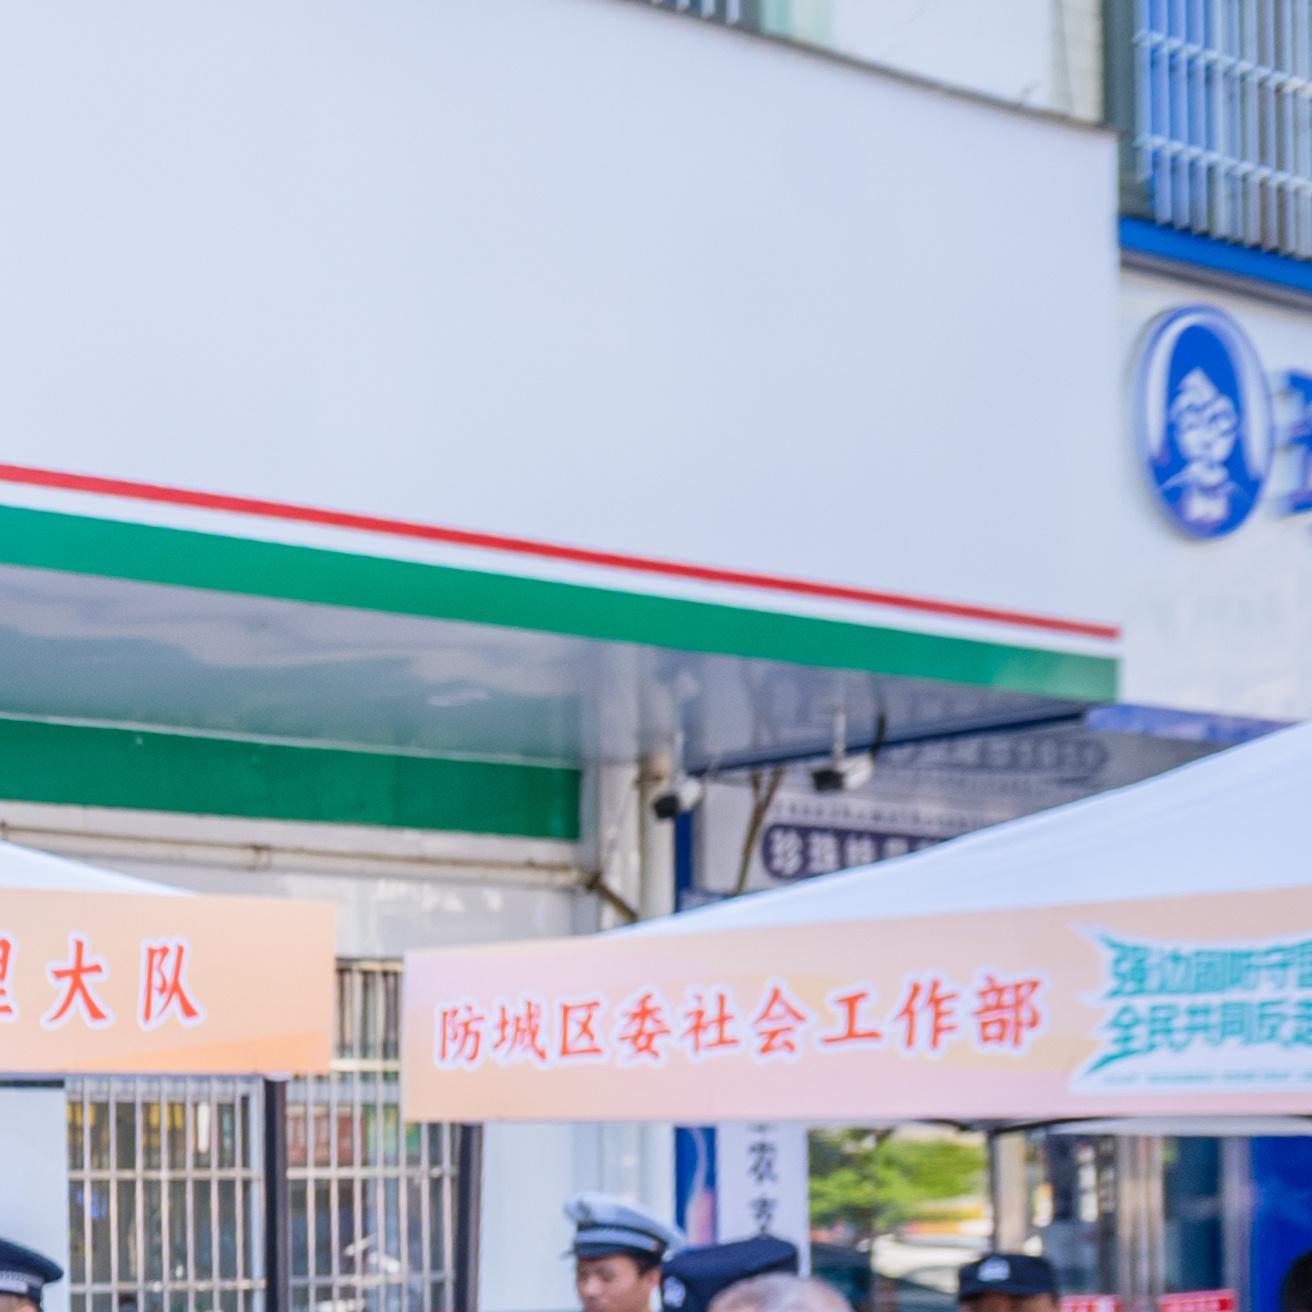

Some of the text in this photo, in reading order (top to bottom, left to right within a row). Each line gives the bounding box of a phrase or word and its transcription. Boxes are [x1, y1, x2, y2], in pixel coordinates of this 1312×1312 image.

[438, 974, 1044, 1061] 防城区委社会工作部
